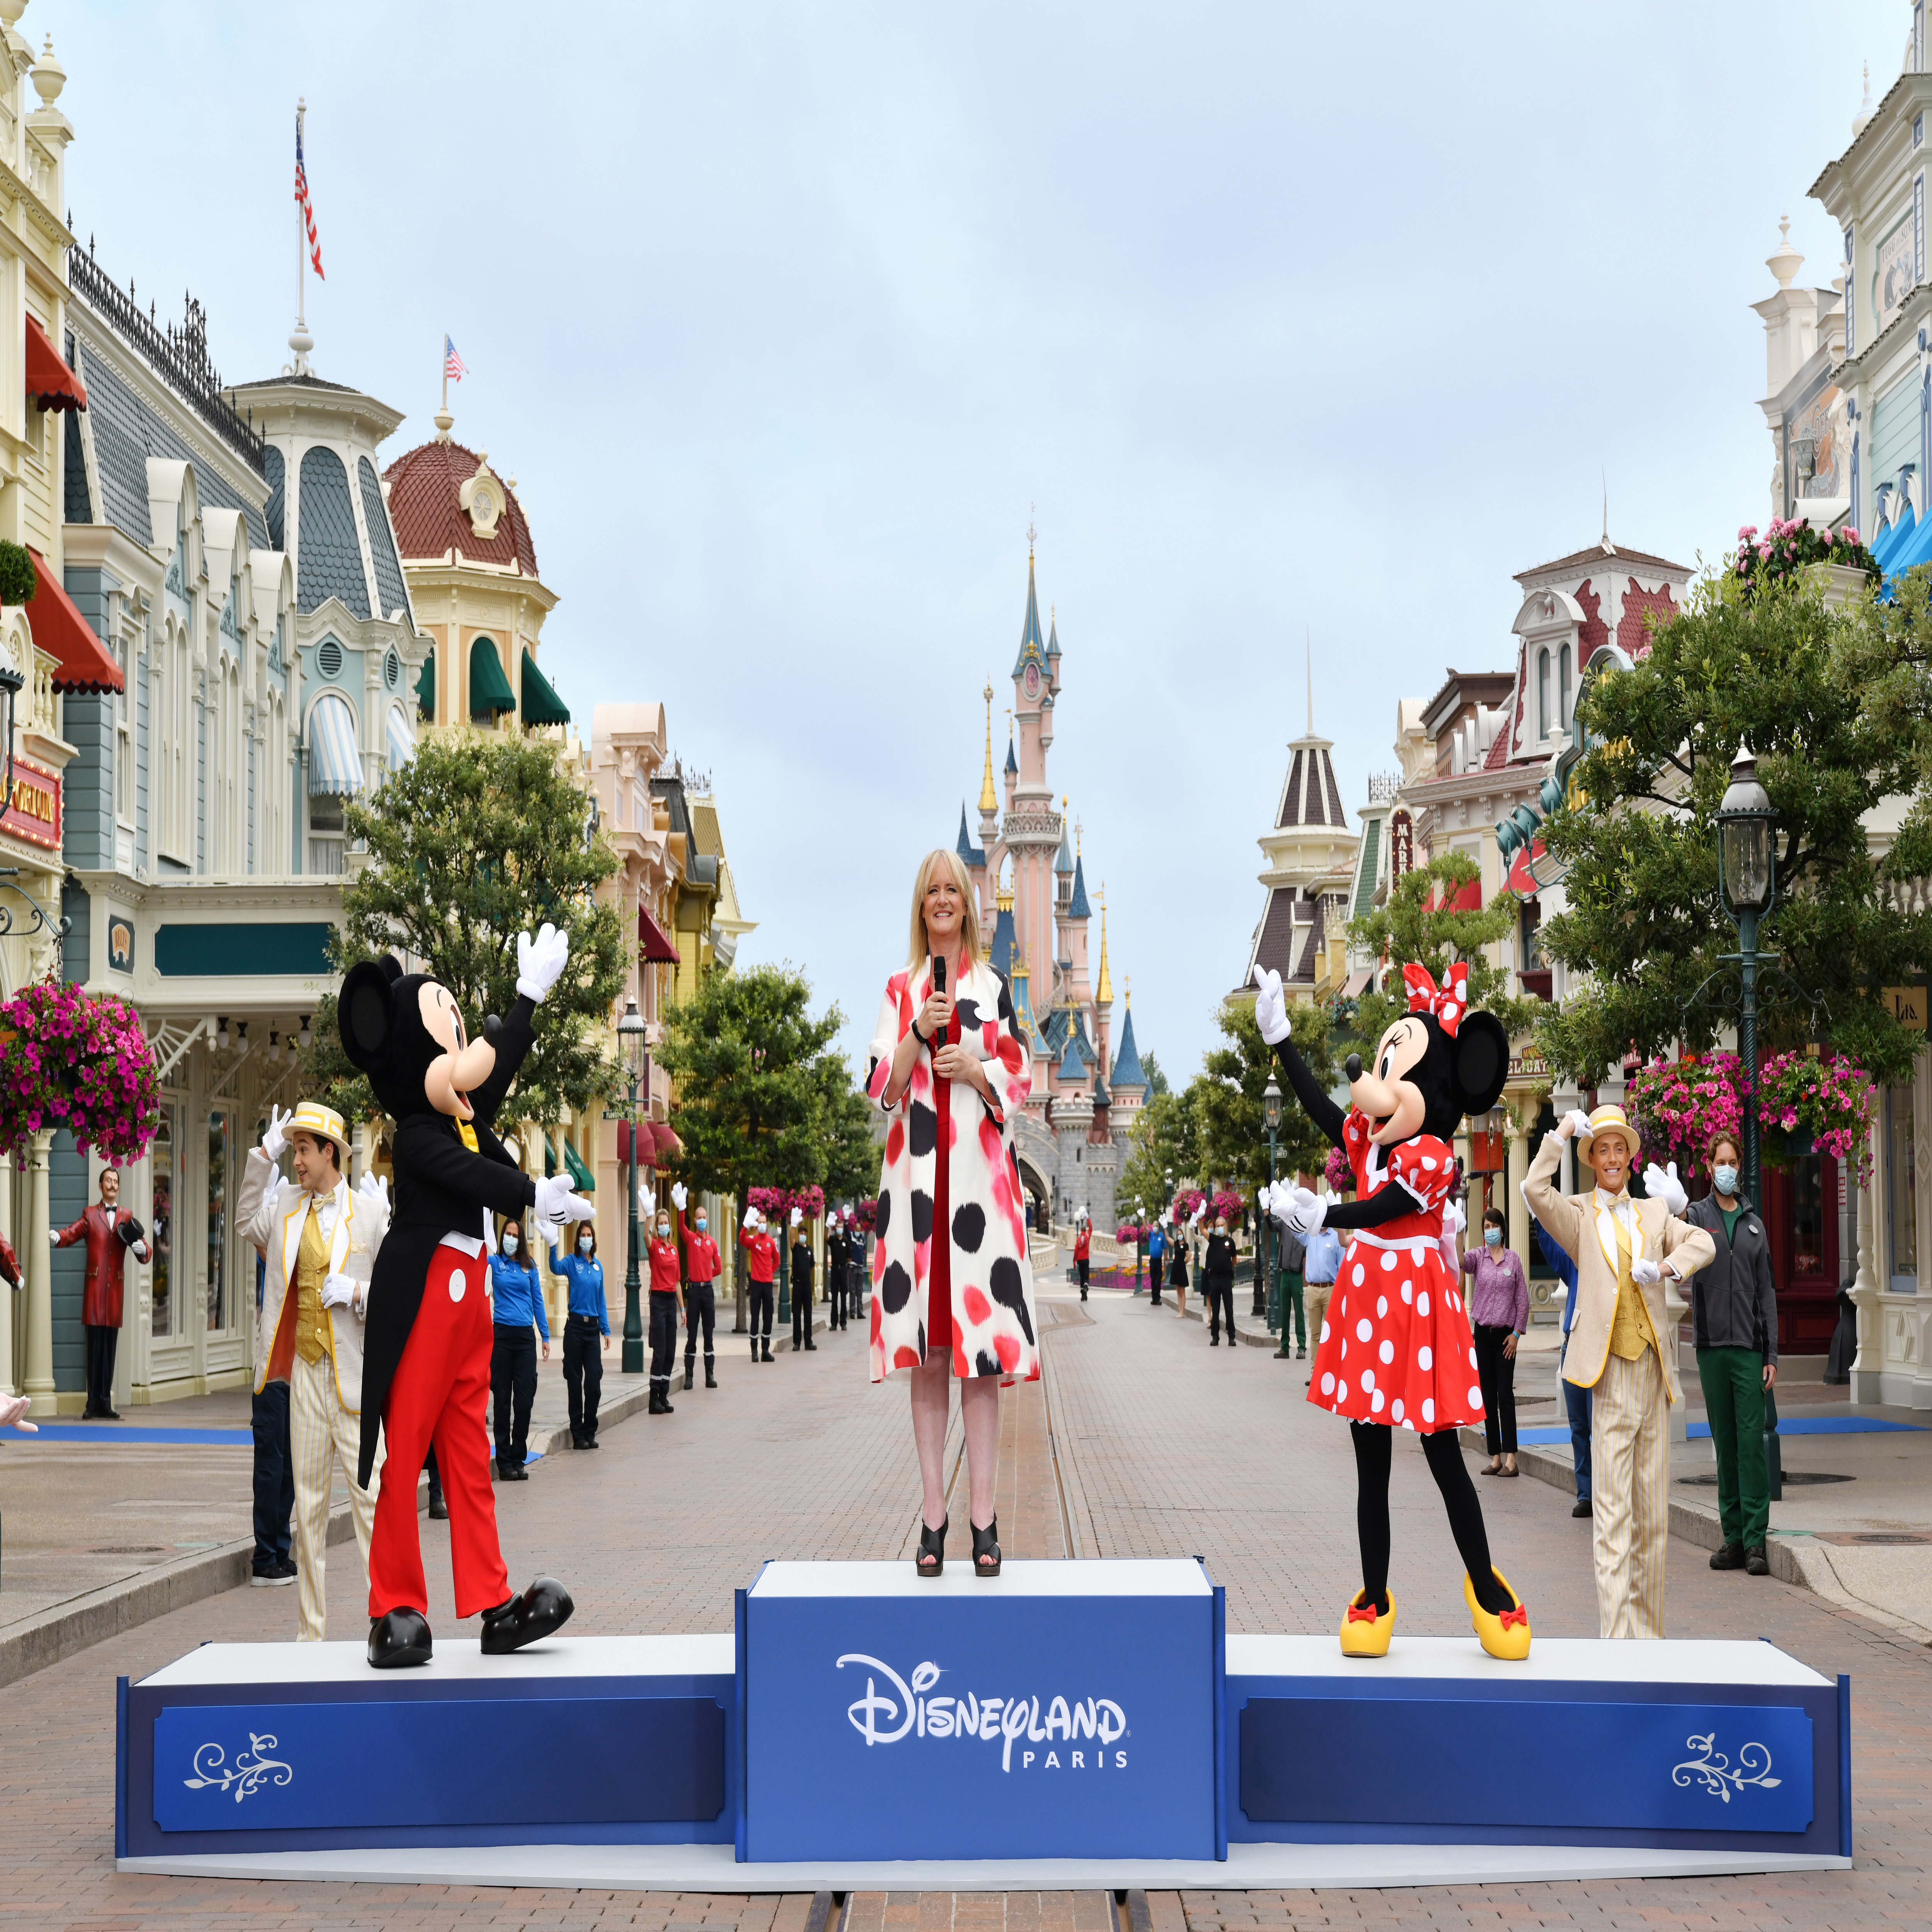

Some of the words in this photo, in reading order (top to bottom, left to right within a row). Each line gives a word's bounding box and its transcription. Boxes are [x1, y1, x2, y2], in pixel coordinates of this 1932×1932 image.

[1882, 238, 1895, 263] TUGG
[1901, 216, 1913, 242] SONS
[1397, 824, 1408, 881] MARK
[115, 929, 127, 950] BELTS
[1023, 1751, 1127, 1768] PARIS
